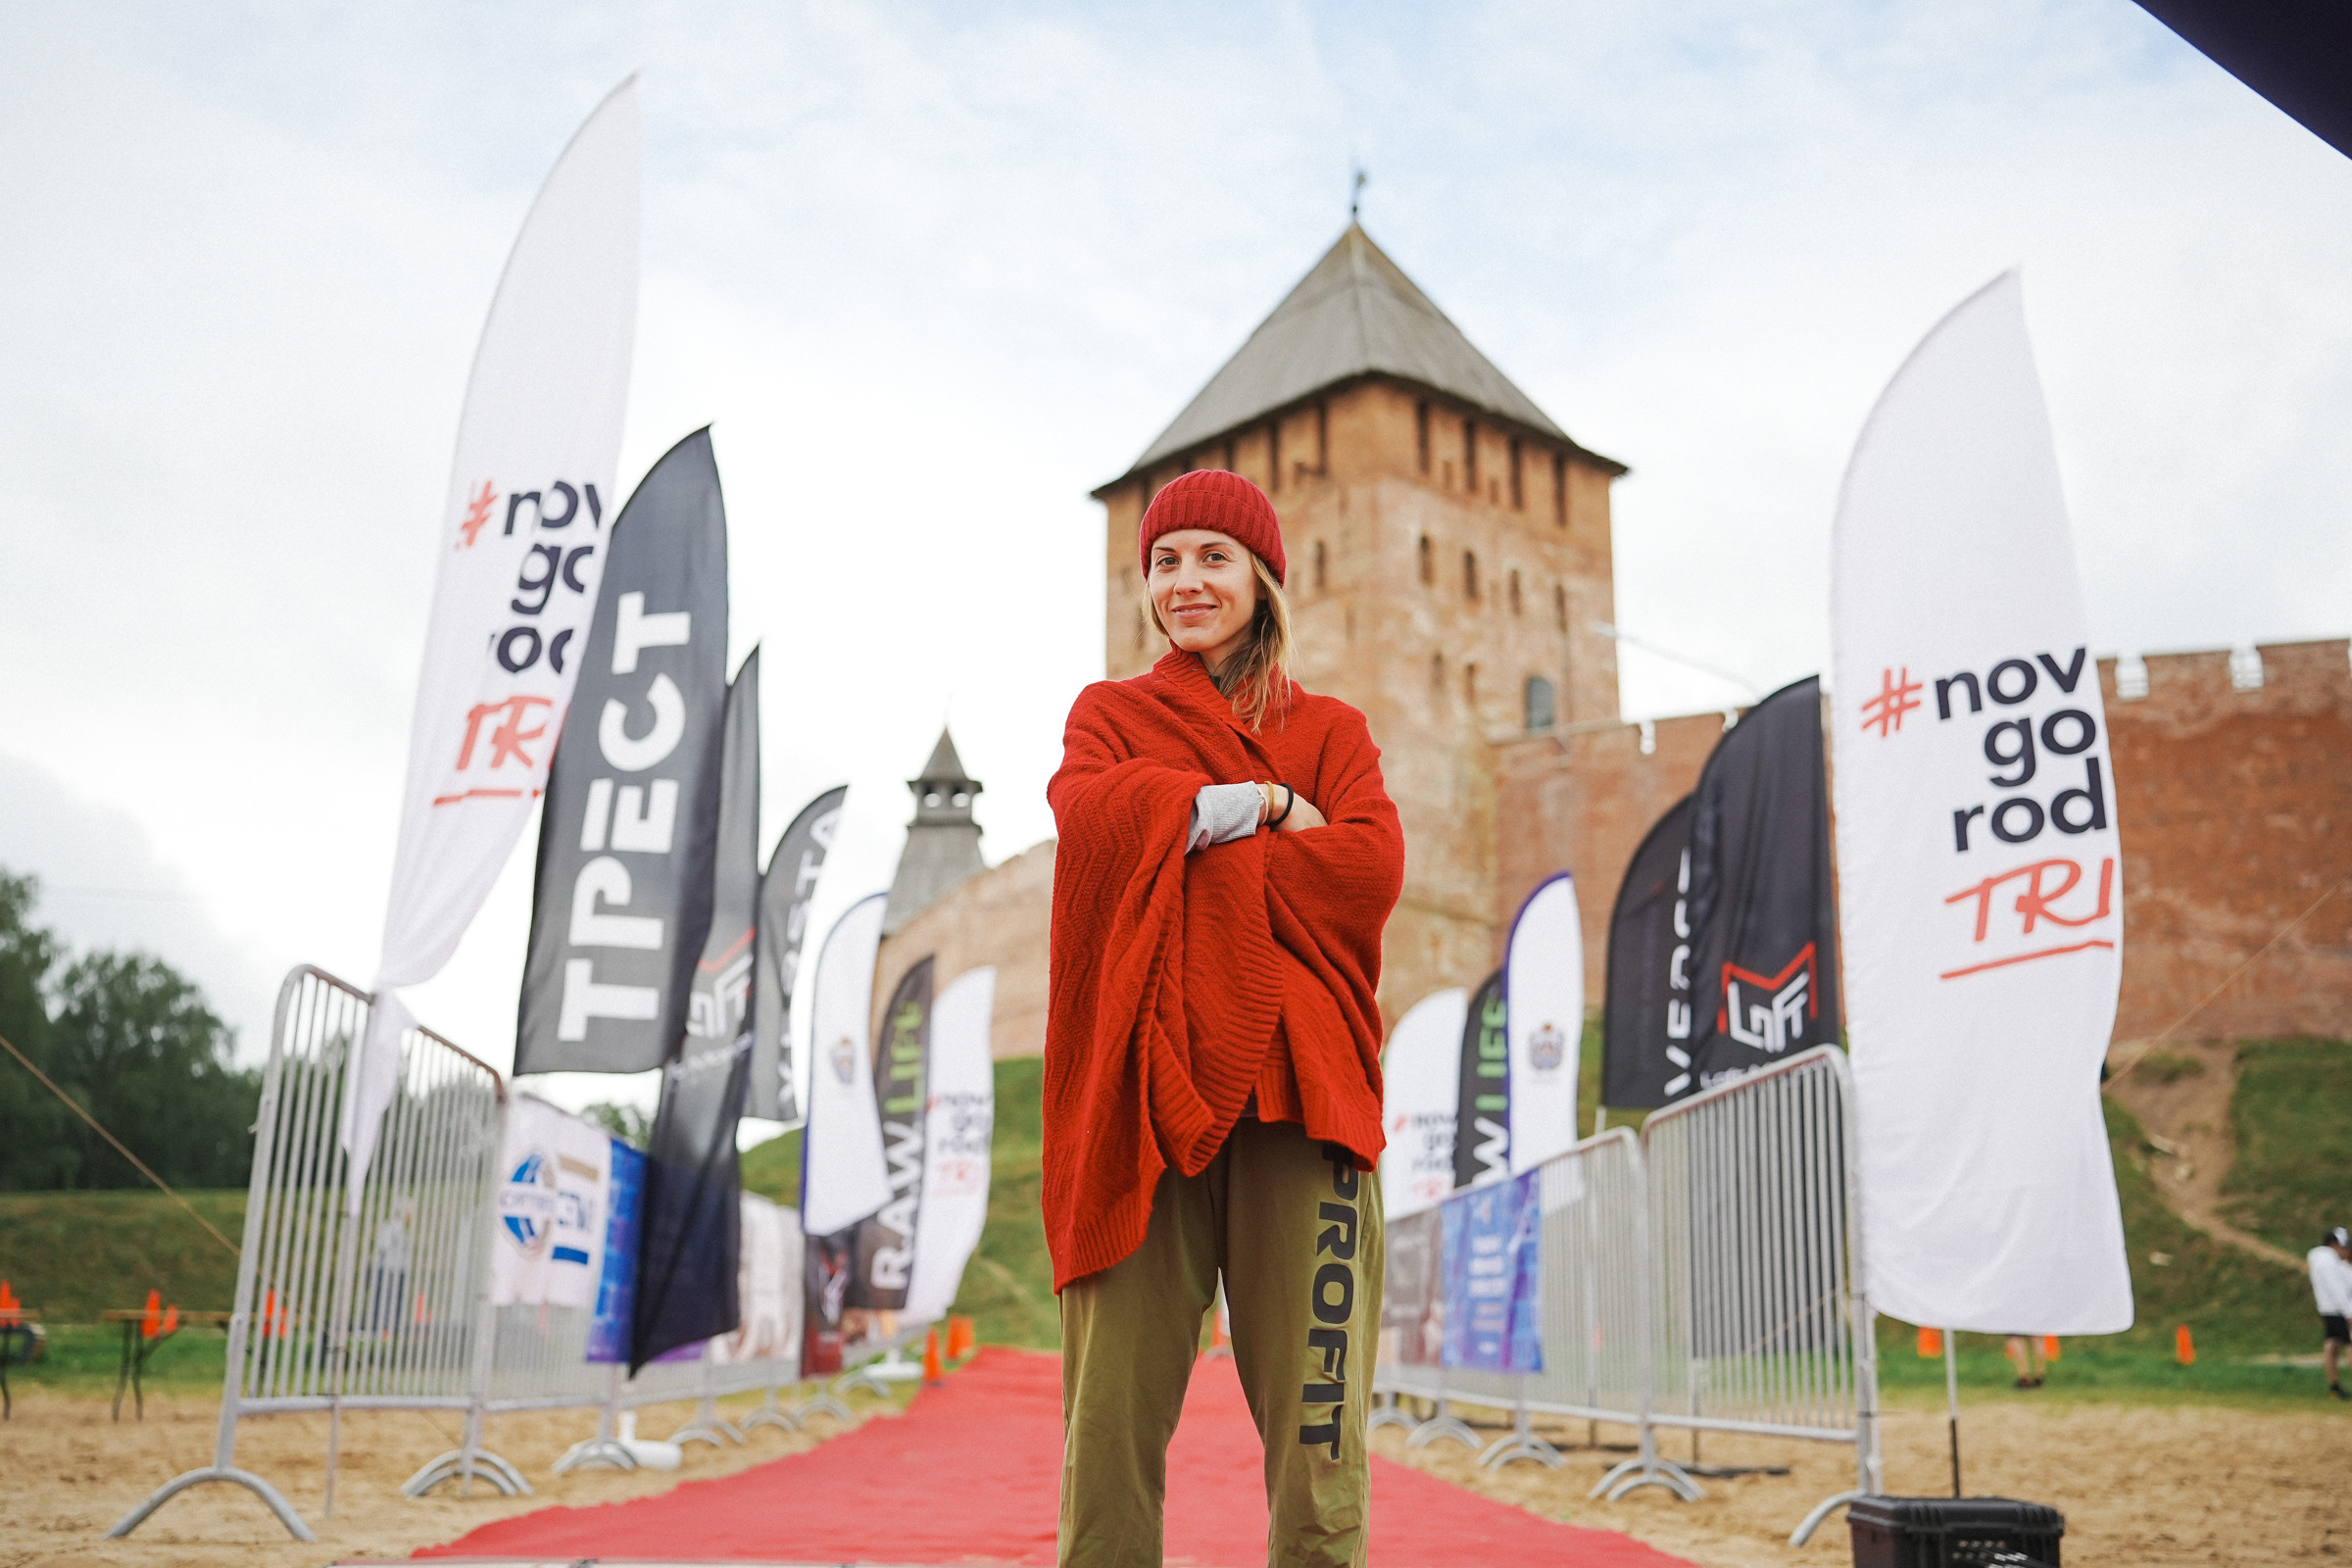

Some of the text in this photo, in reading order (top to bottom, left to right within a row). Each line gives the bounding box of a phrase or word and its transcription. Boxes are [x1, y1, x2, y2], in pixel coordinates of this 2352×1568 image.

[1984, 709, 2097, 788] go
[1952, 756, 2108, 853] rod
[1944, 858, 2115, 942] TRI
[1299, 1141, 1359, 1461] PROFIT
